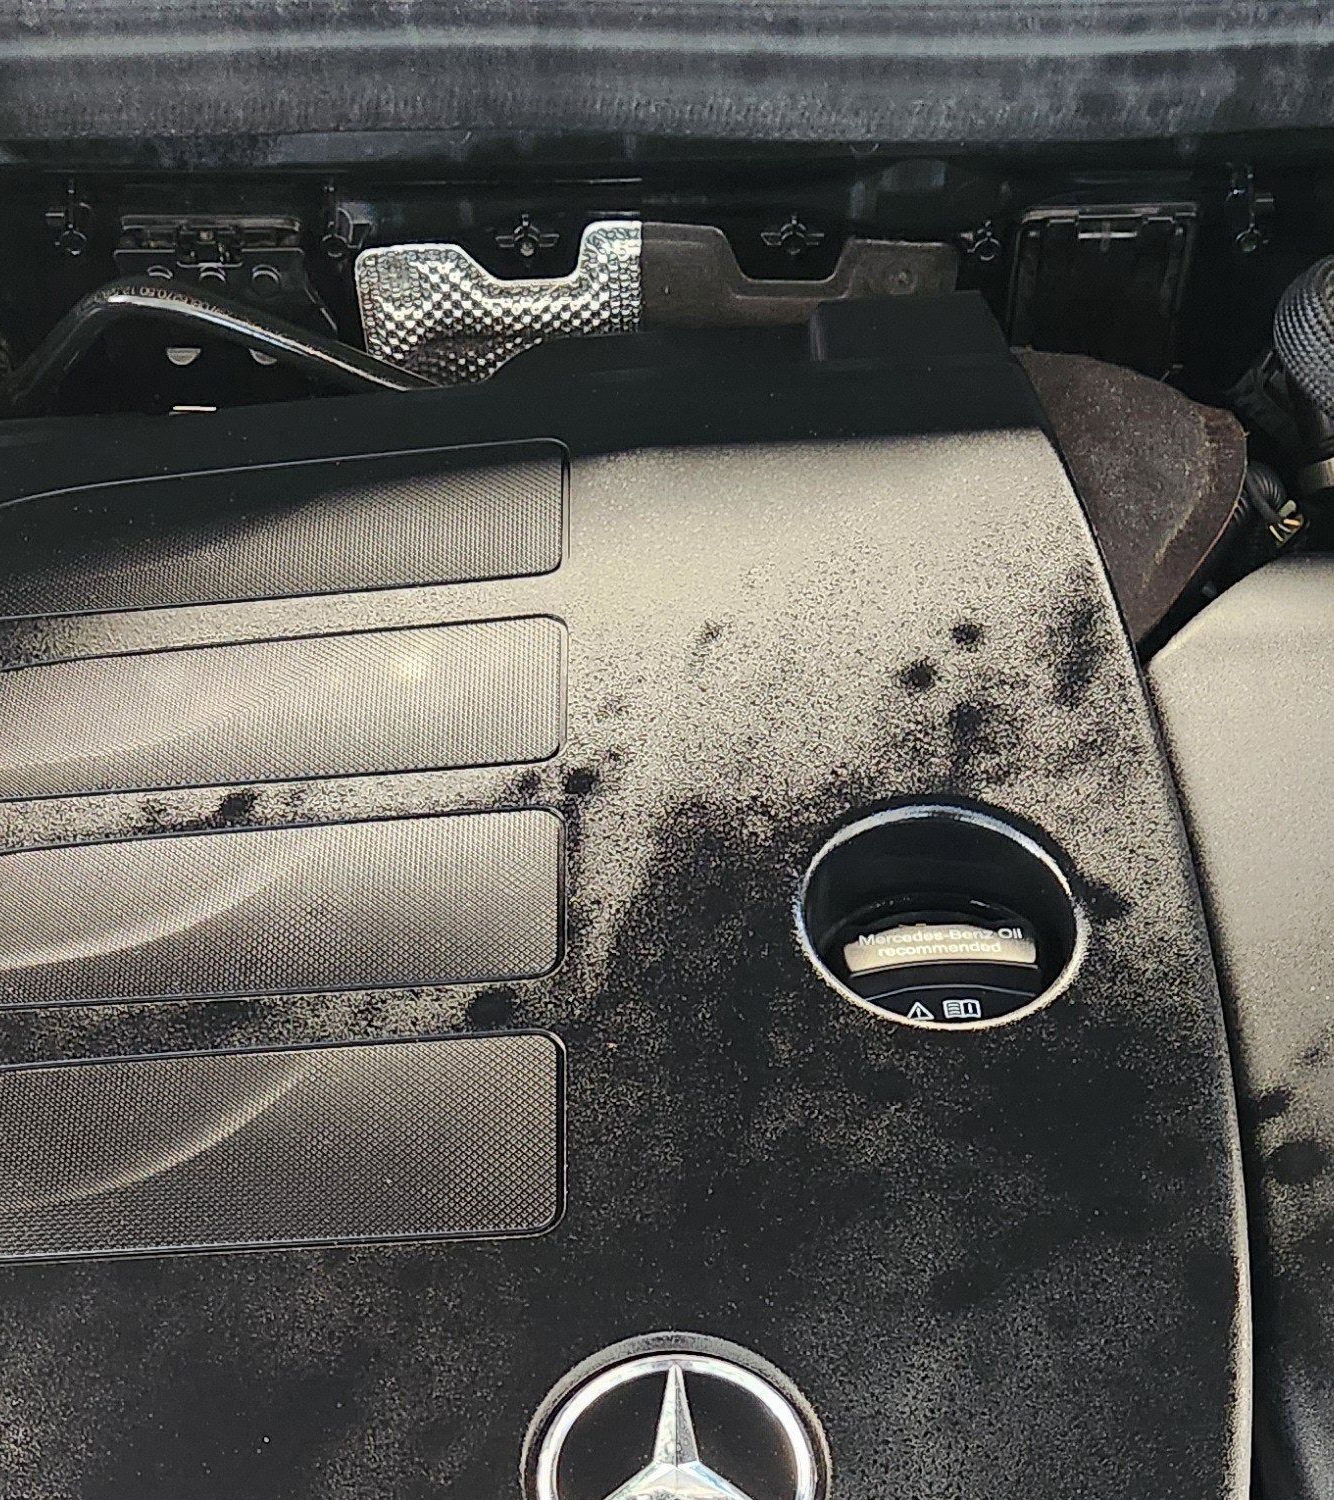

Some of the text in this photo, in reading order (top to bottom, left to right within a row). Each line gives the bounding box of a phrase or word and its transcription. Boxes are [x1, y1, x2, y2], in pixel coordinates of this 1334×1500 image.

[858, 925, 1023, 947] Mercedes-Benz Oil
[877, 941, 1003, 957] recommended
